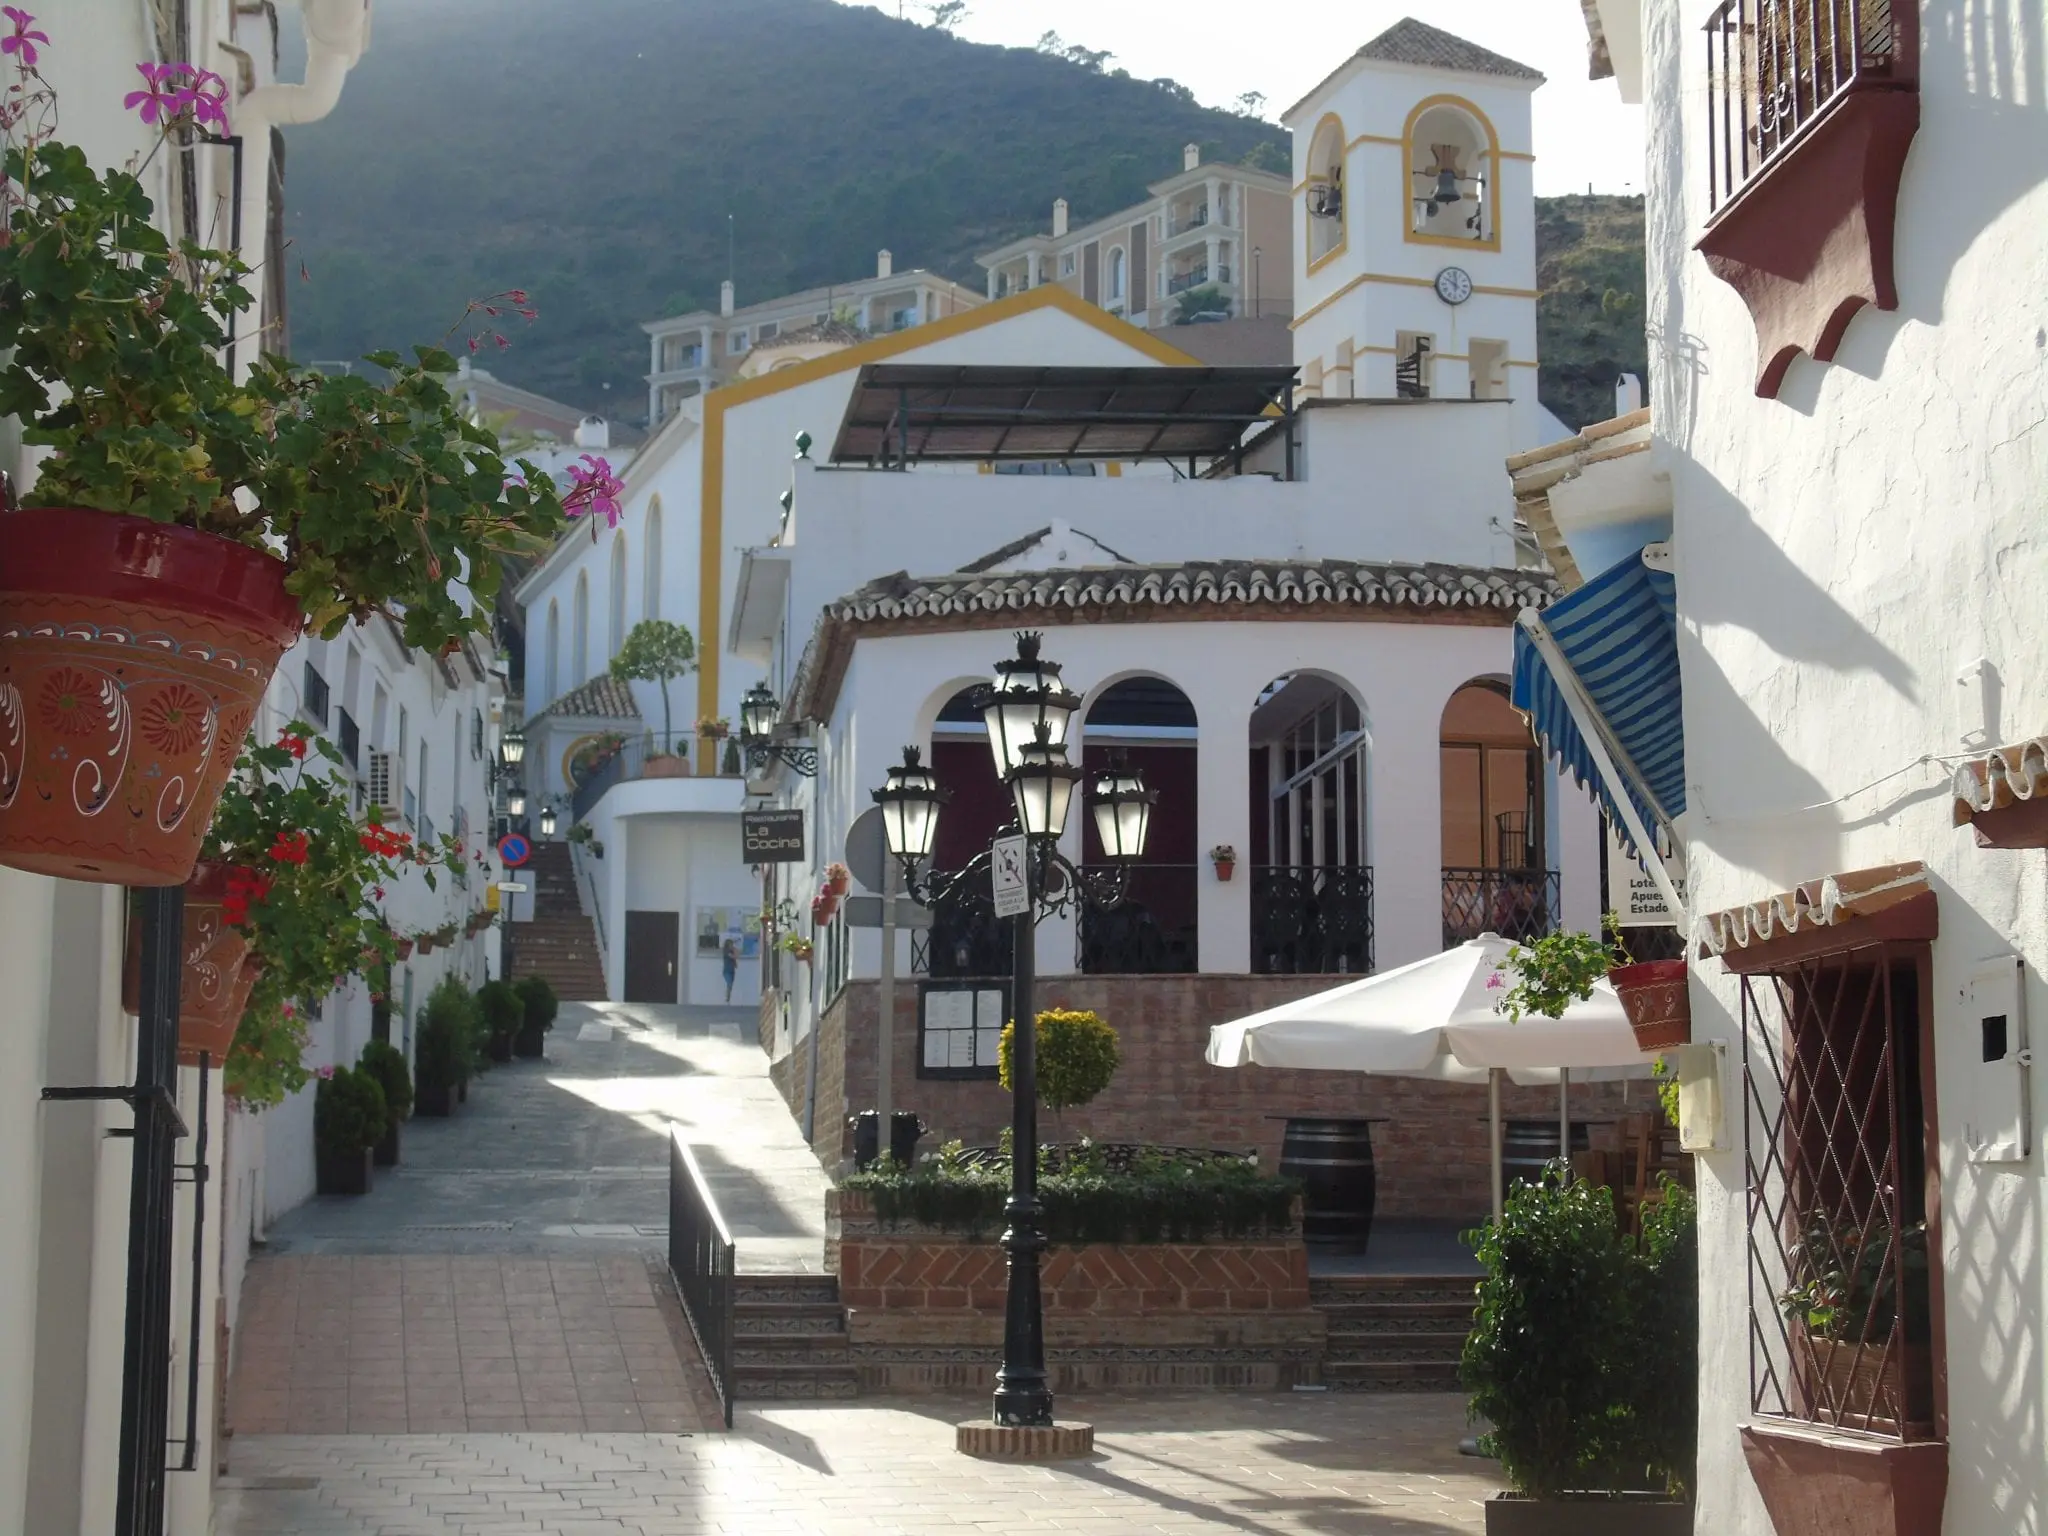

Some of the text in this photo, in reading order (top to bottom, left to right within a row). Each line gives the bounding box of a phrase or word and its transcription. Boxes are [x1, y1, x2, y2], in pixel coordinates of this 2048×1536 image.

[746, 825, 769, 837] La
[746, 837, 801, 850] Cocina
[1630, 879, 1685, 889] Lotes y
[1631, 891, 1682, 903] Apuess
[1630, 902, 1669, 914] Estado
